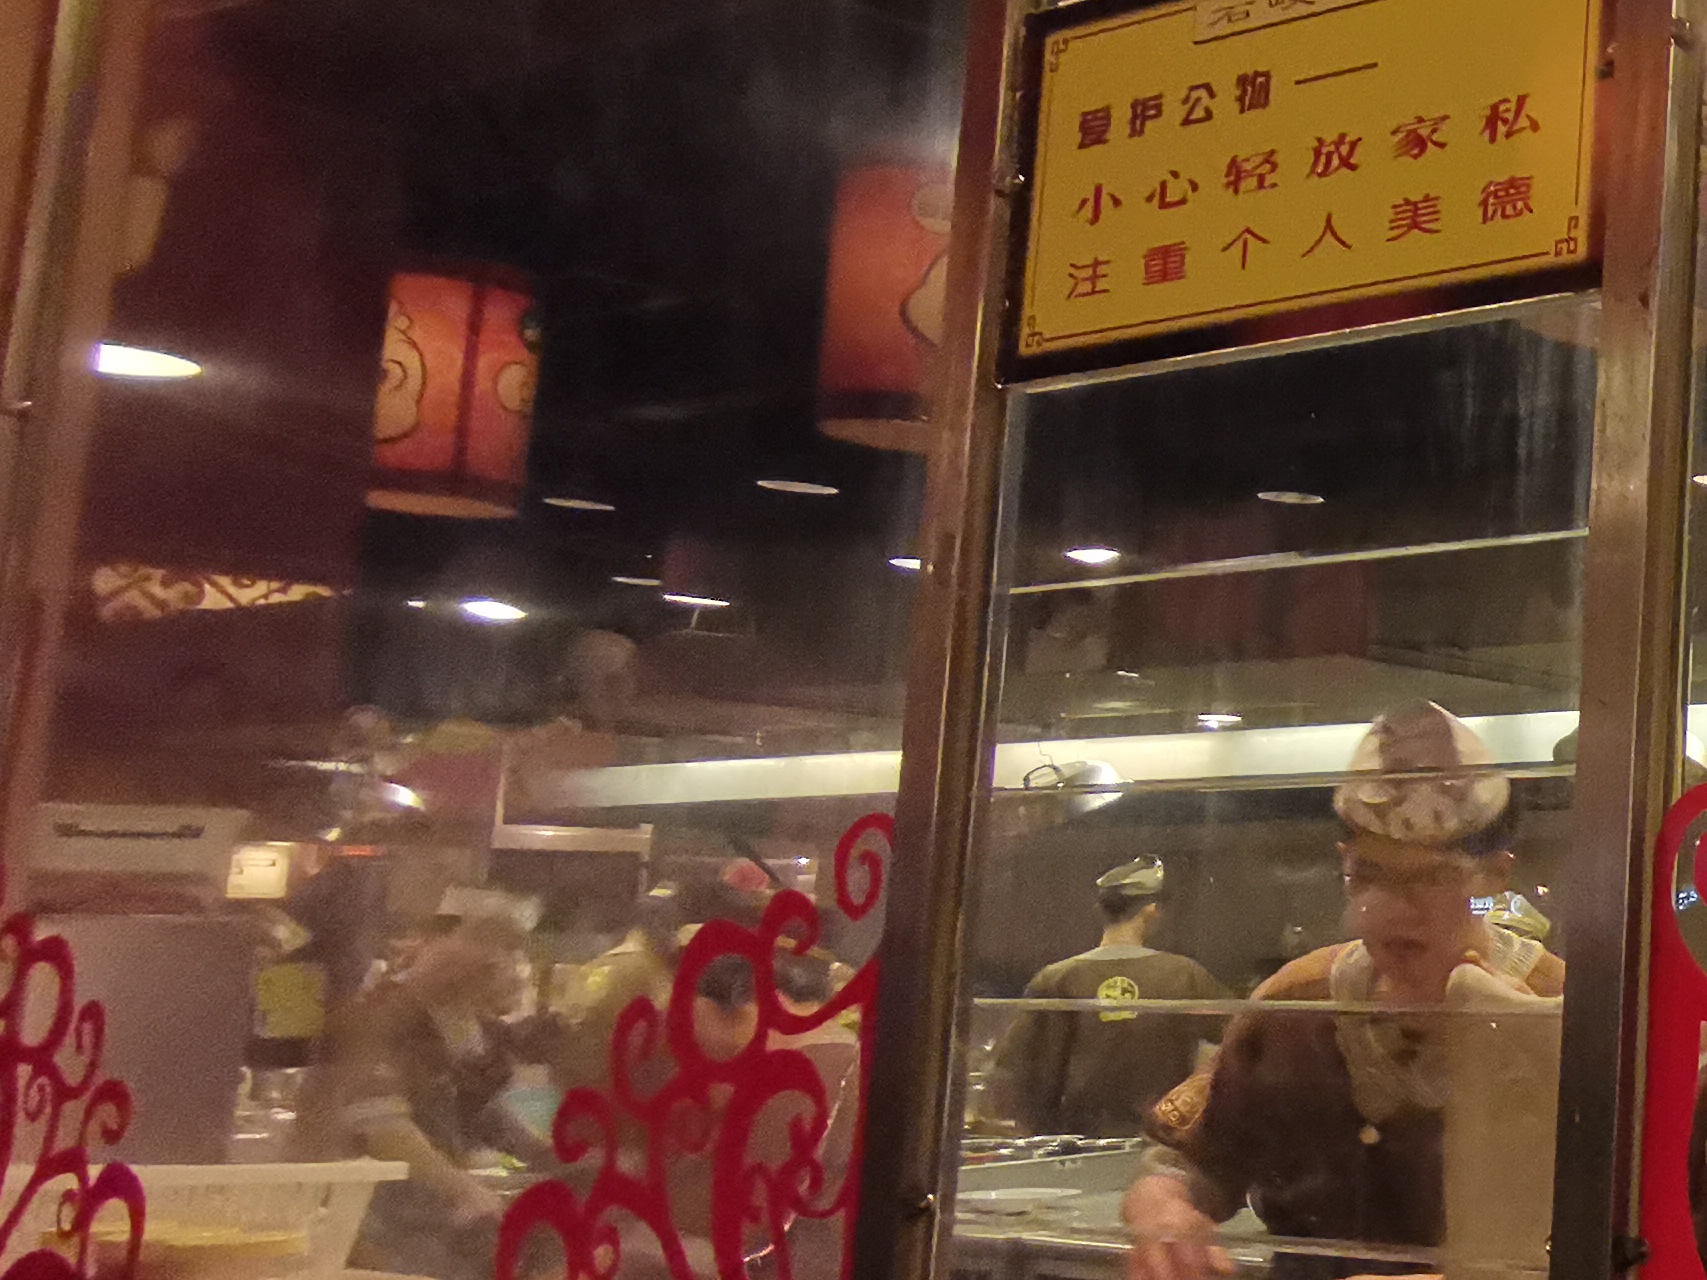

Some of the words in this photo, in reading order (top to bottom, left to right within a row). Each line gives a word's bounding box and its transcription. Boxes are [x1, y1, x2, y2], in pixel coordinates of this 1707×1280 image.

[1074, 94, 1541, 226] 小心轻放家私
[1066, 176, 1534, 300] 注重个人美德
